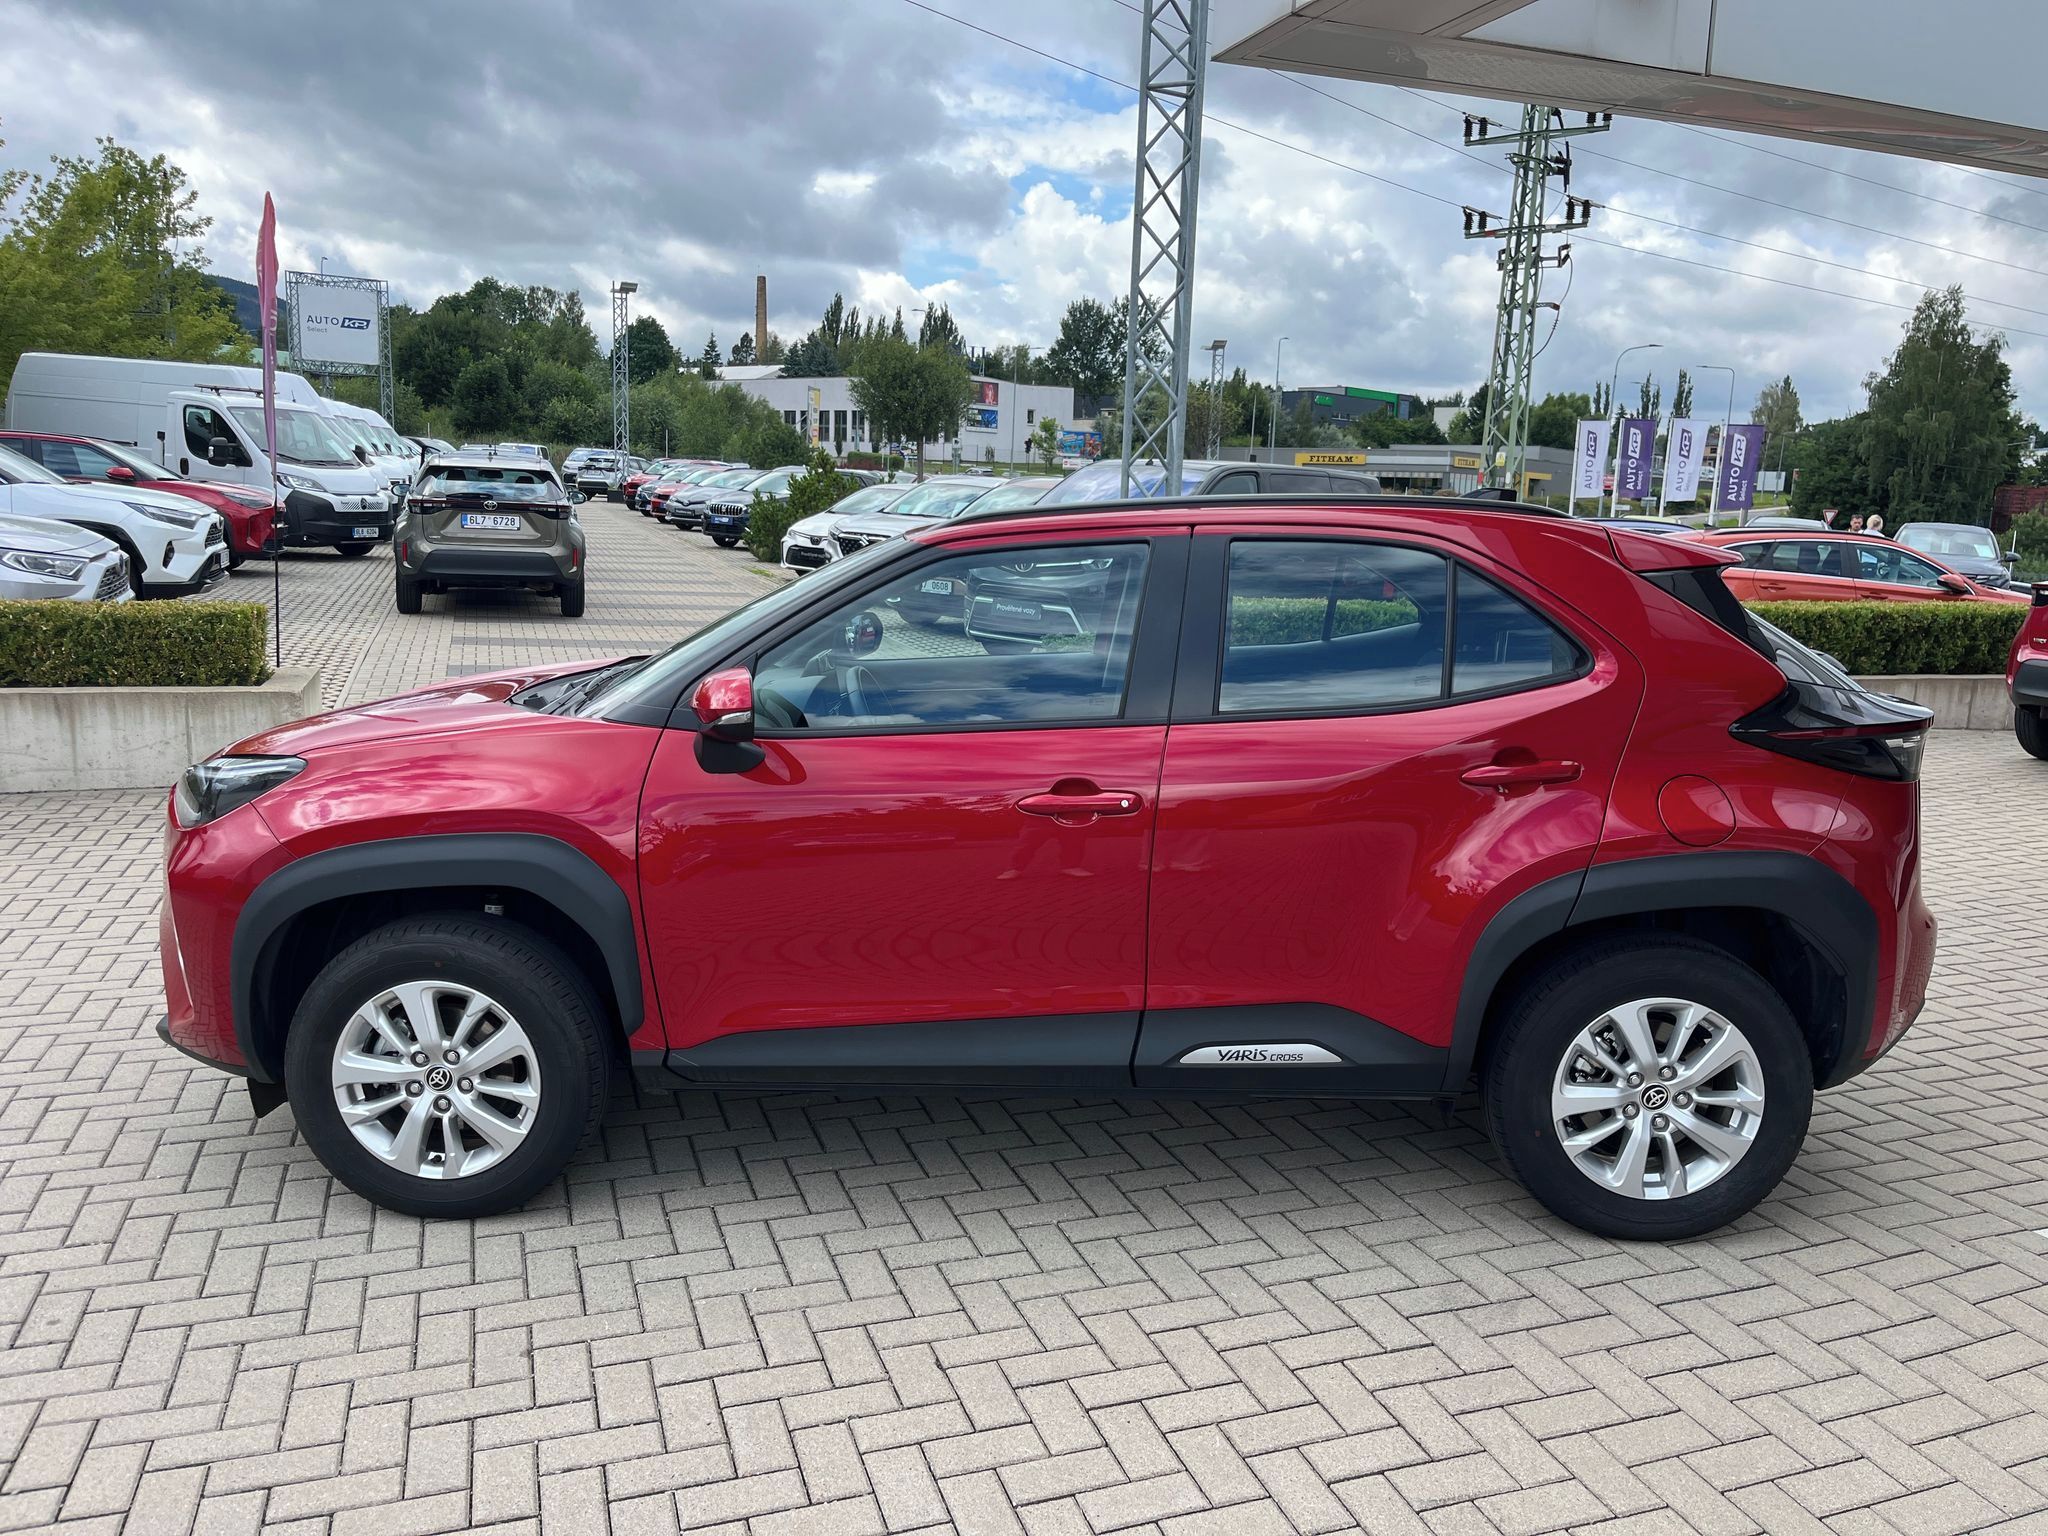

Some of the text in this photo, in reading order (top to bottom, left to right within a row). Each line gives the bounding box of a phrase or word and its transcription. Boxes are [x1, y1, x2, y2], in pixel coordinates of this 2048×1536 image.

[306, 314, 340, 326] AUTO
[1309, 455, 1354, 463] FITHAM
[1584, 459, 1594, 490] AUTO
[1626, 458, 1637, 490] AUTO
[1676, 460, 1686, 492] AUTO
[1727, 467, 1740, 502] AUTO
[1740, 480, 1748, 502] Select
[469, 515, 516, 526] 6L7 6728
[932, 581, 948, 591] 0608
[1022, 608, 1036, 616] vozy
[1270, 1053, 1304, 1062] CROSS
